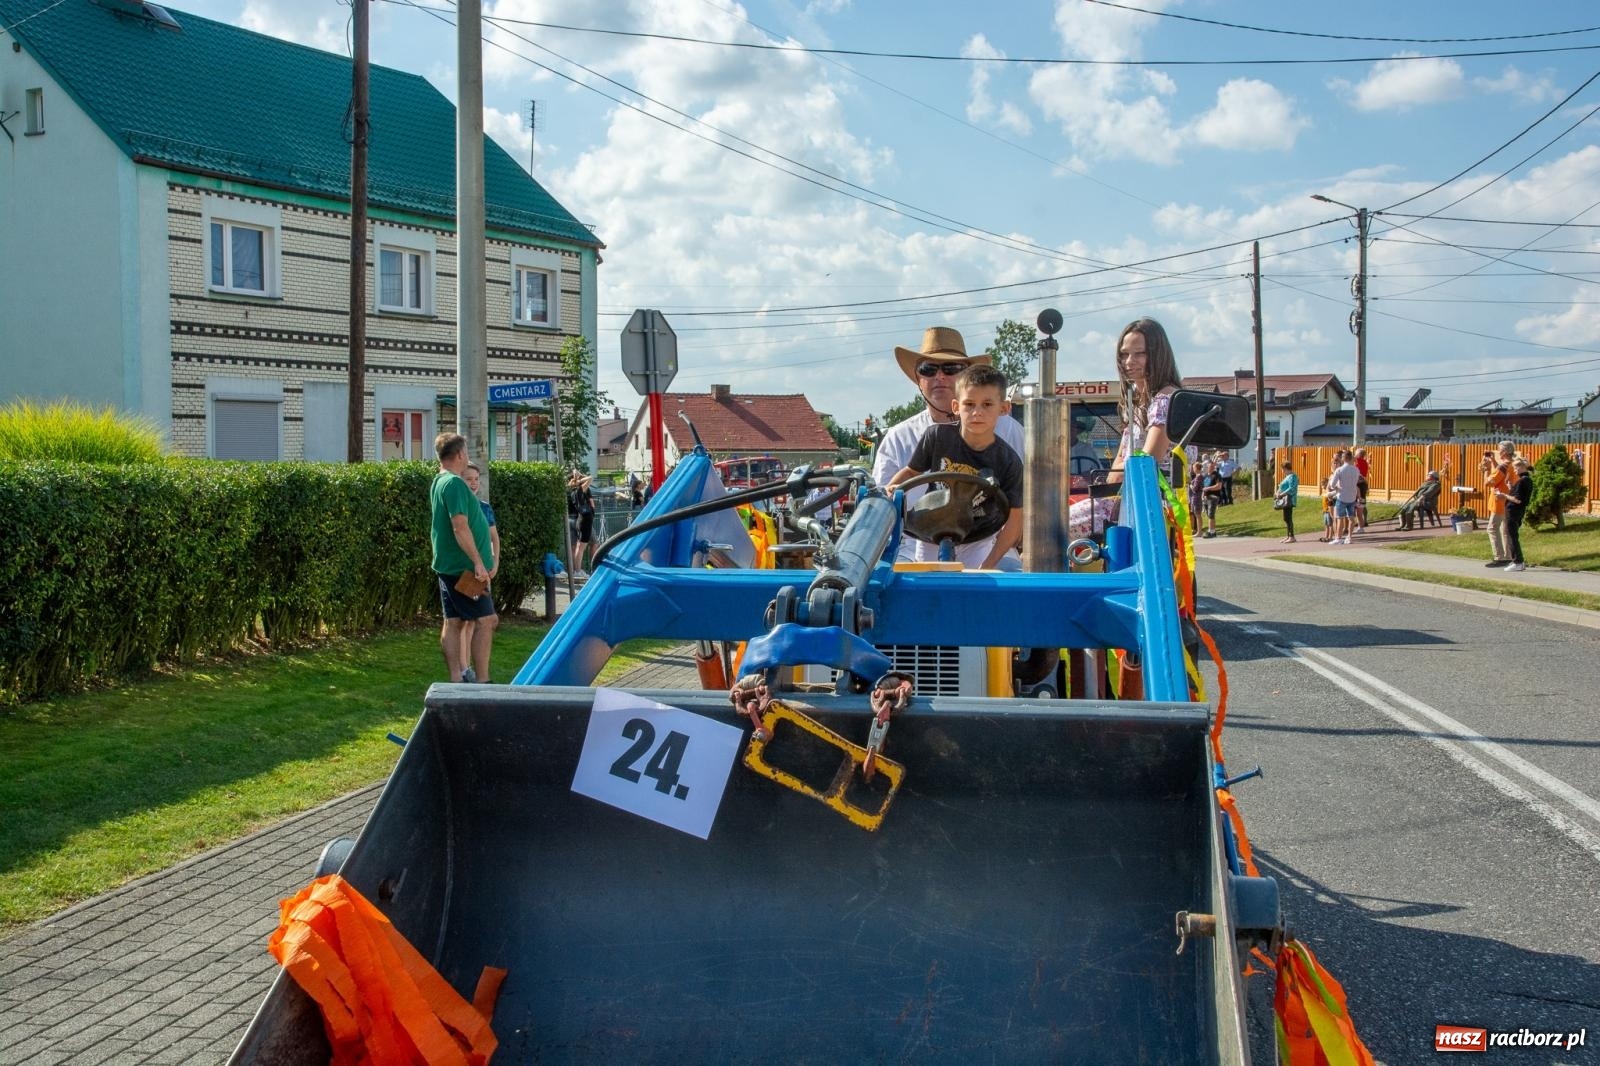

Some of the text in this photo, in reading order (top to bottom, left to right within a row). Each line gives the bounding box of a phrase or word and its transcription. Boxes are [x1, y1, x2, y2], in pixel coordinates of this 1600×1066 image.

[494, 384, 546, 398] CMENTARZ
[1056, 385, 1109, 395] ZETOR
[608, 718, 691, 801] 24.
